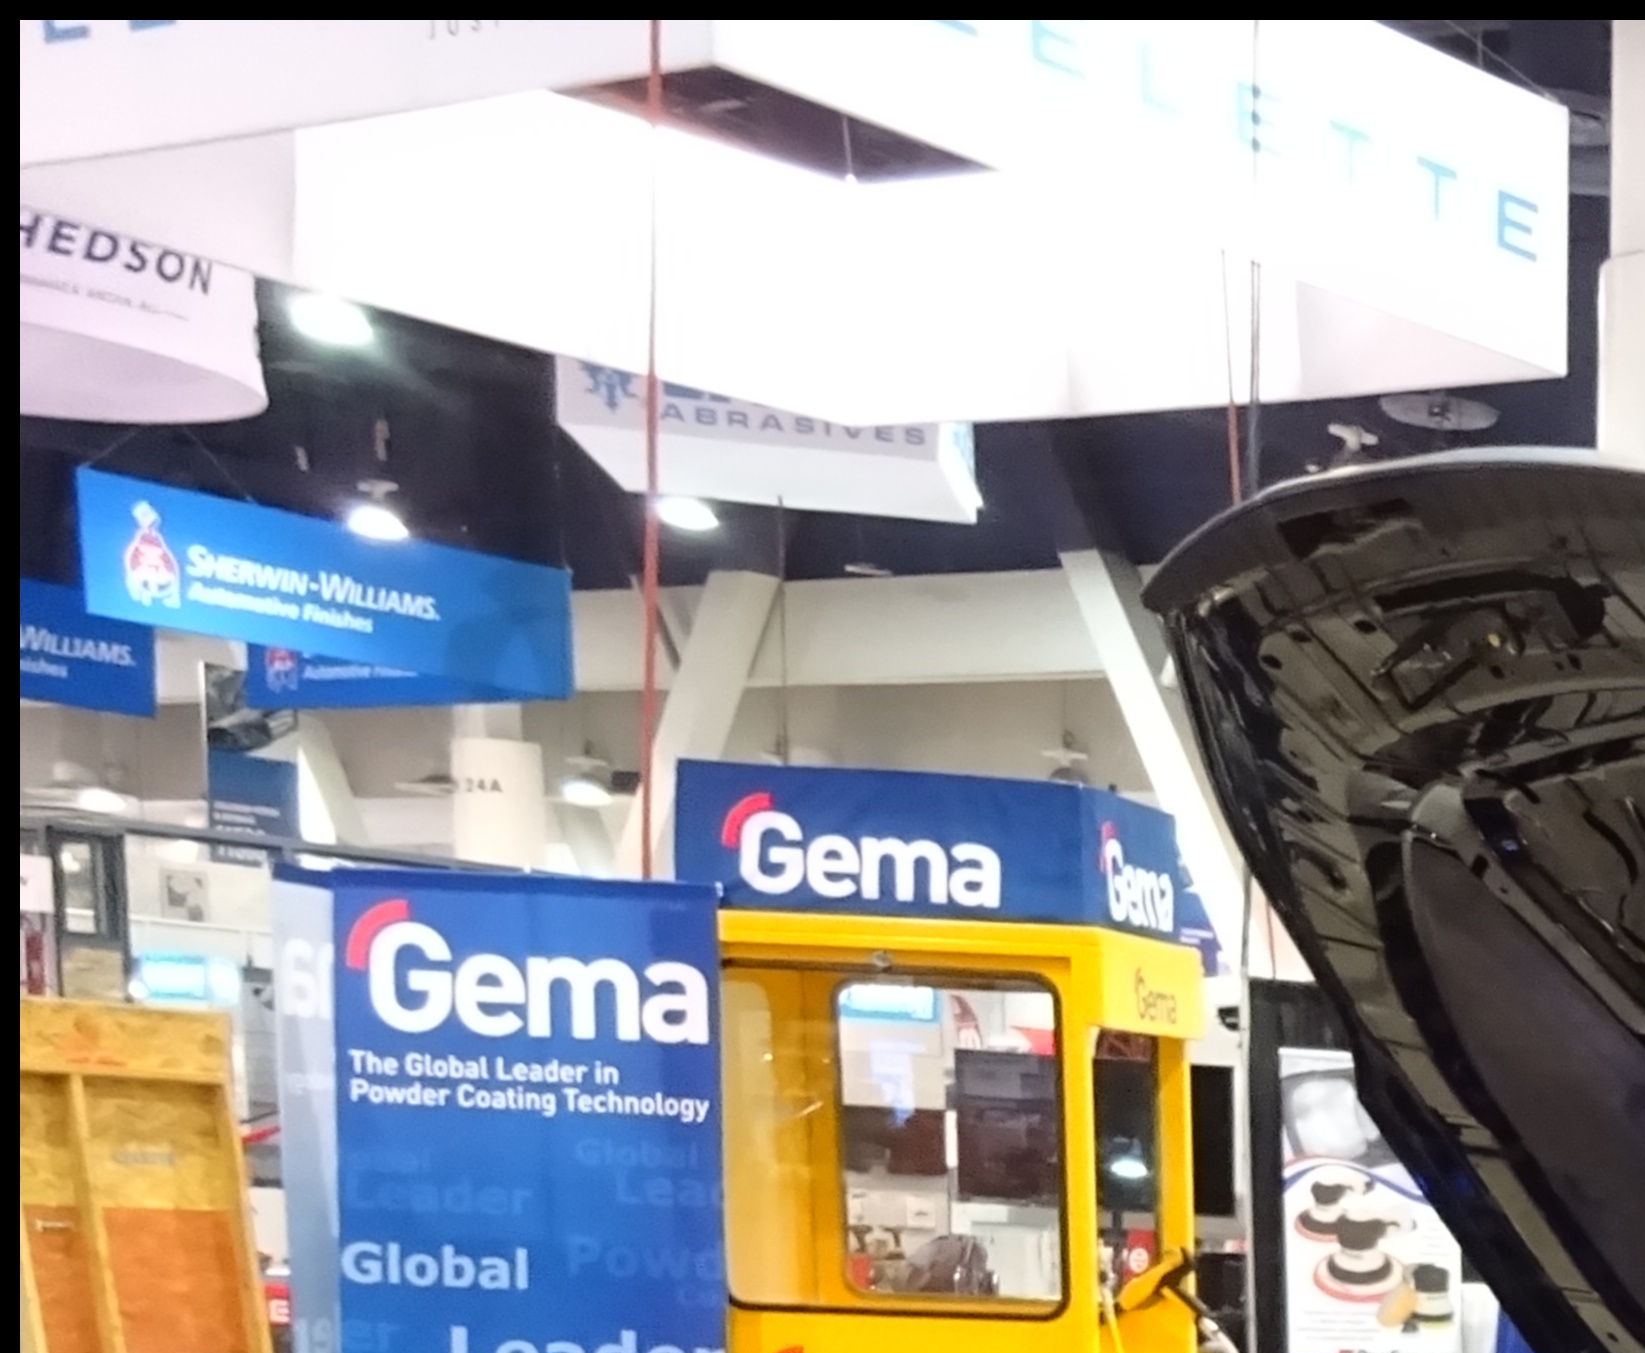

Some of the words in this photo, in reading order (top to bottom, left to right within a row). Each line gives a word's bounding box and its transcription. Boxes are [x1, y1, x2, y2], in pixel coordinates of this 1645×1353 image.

[659, 401, 927, 446] ABRASIVES
[187, 582, 300, 621] Automotive
[302, 603, 374, 634] Finishes
[738, 808, 1001, 909] Gema
[1105, 832, 1175, 933] Gema
[367, 919, 712, 1045] Gema
[1134, 972, 1178, 1026] Gema
[349, 1049, 399, 1077] The
[404, 1051, 489, 1080] Global
[495, 1055, 589, 1084] Leader
[594, 1060, 620, 1085] in
[349, 1078, 451, 1107] Powder
[456, 1085, 557, 1117] Coating
[562, 1088, 711, 1123] Technology
[341, 1240, 530, 1291] Global
